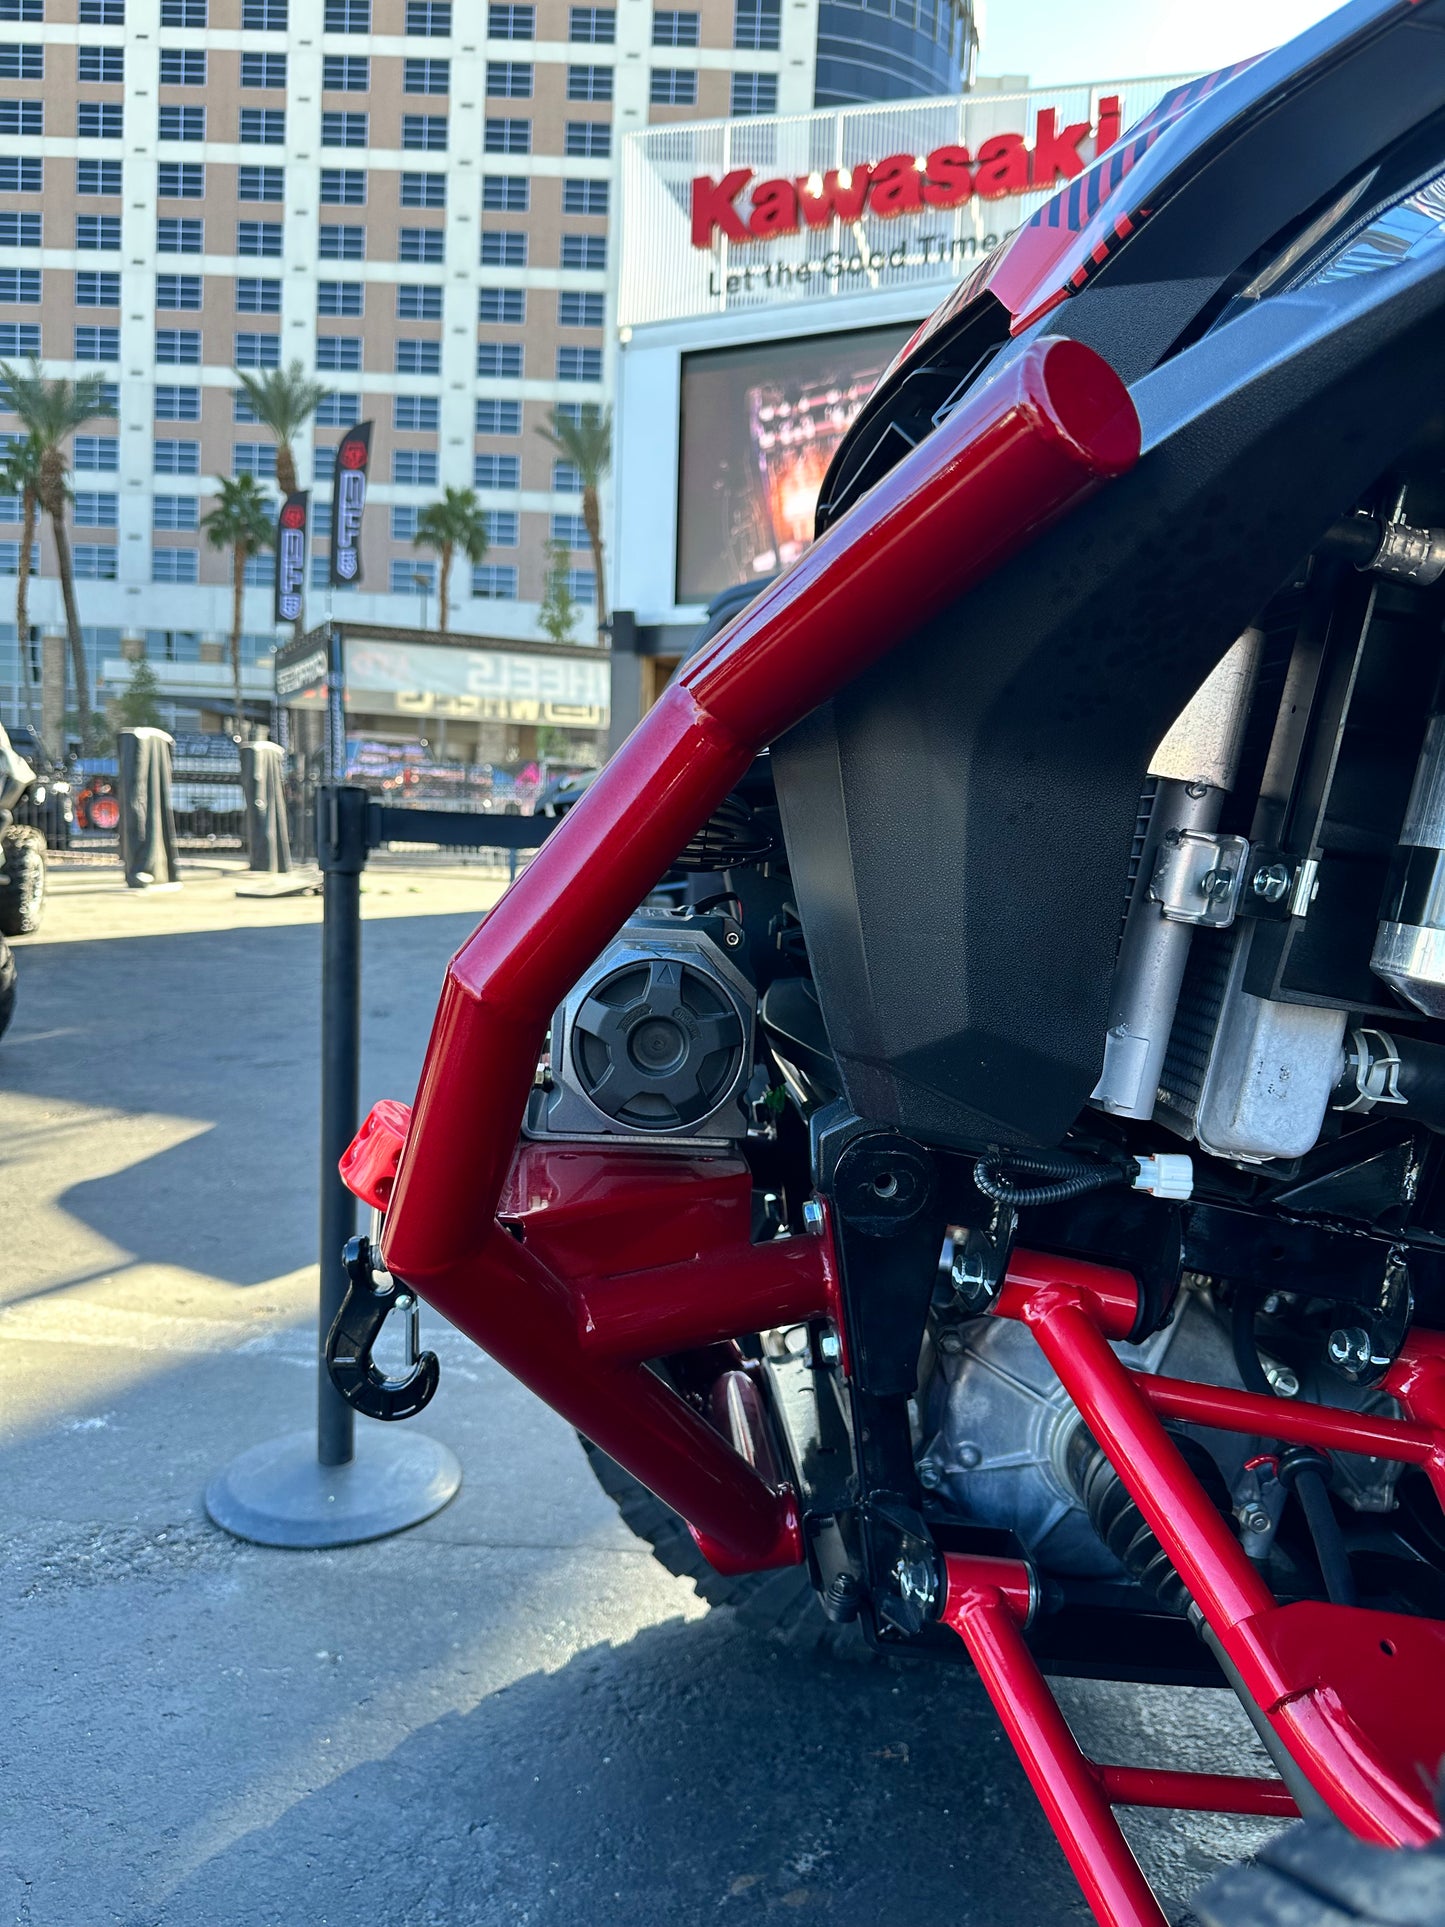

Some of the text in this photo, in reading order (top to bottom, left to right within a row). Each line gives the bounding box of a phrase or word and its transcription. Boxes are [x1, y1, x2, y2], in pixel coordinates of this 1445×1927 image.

[690, 95, 1121, 249] Kawasaki
[708, 230, 1015, 297] Let the Good Time
